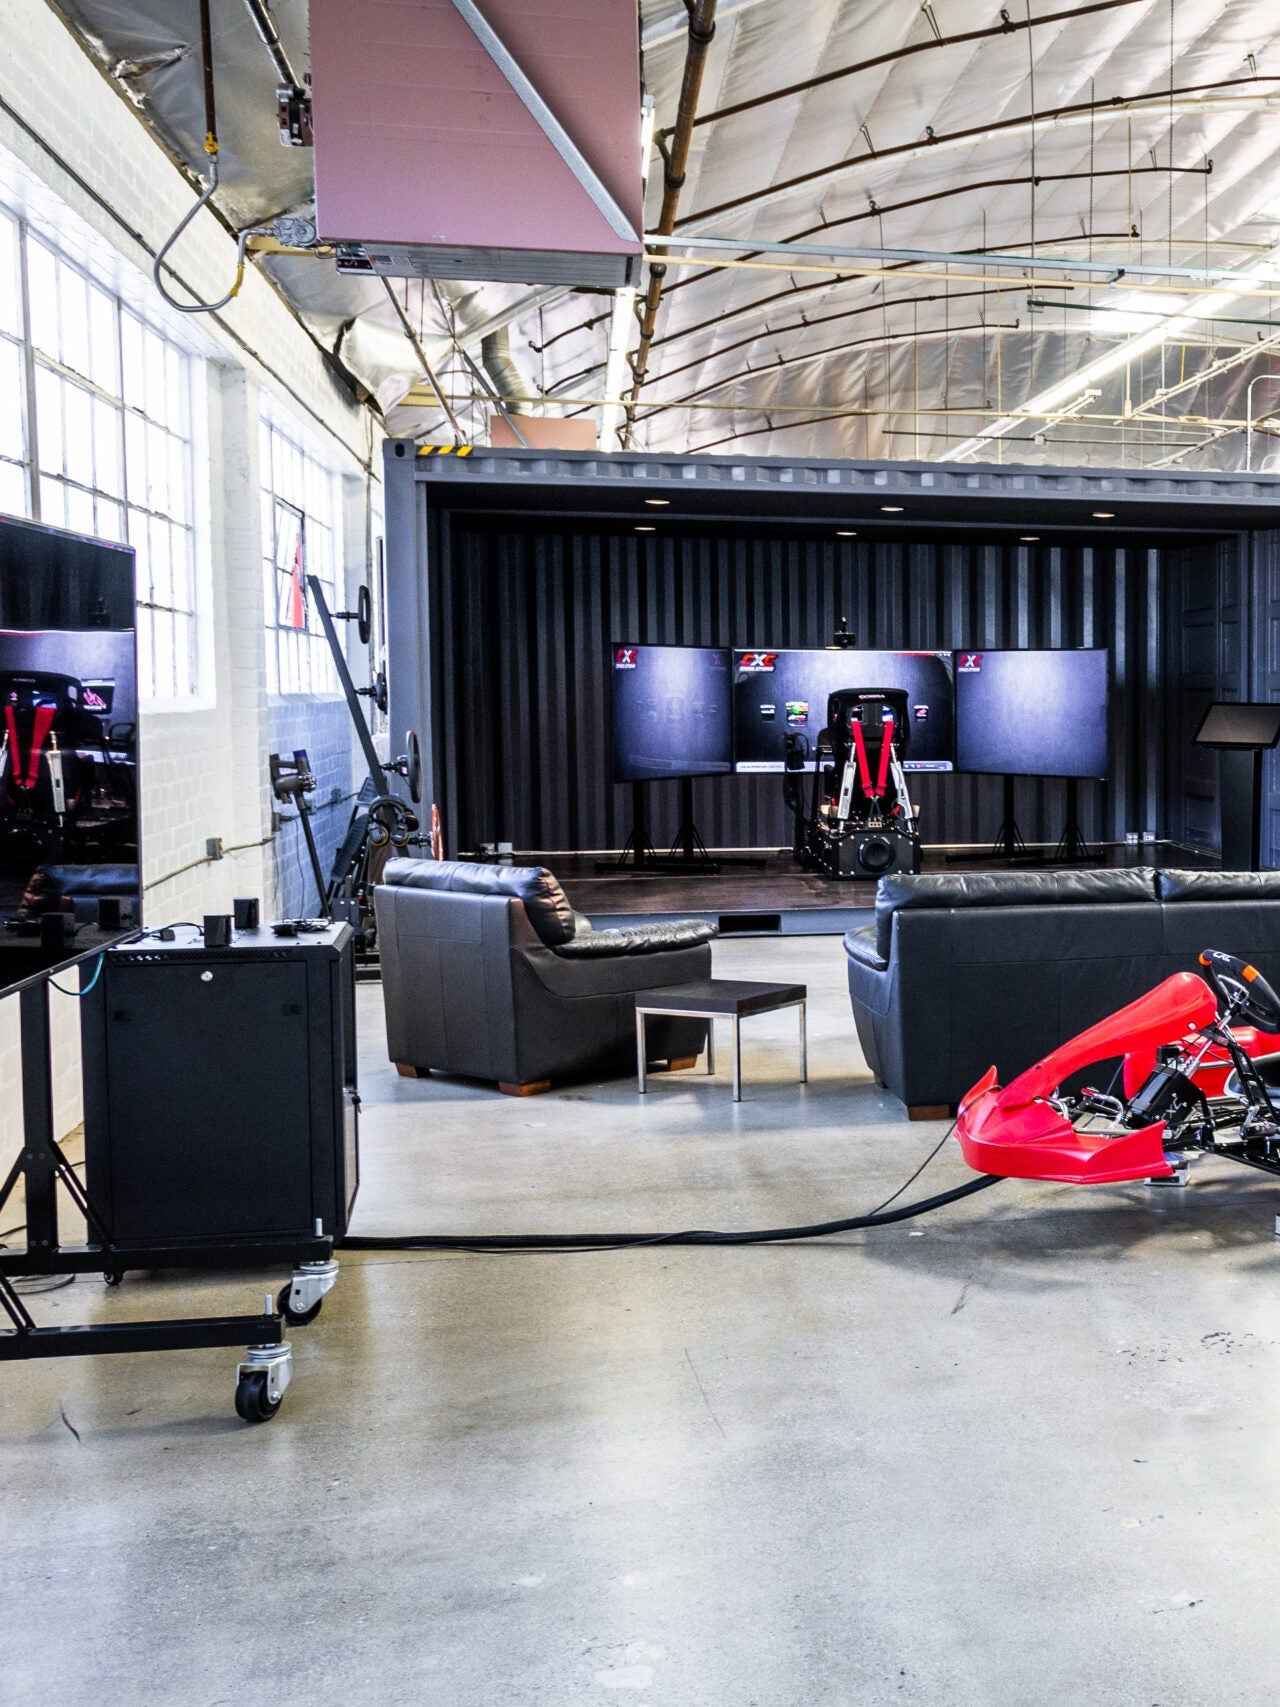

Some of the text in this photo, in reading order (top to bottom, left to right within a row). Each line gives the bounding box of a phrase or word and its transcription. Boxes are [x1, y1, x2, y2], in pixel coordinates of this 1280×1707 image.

[617, 650, 638, 663] CXC
[741, 653, 777, 666] CXC
[960, 655, 983, 667] CXC
[1213, 951, 1232, 962] CXC
